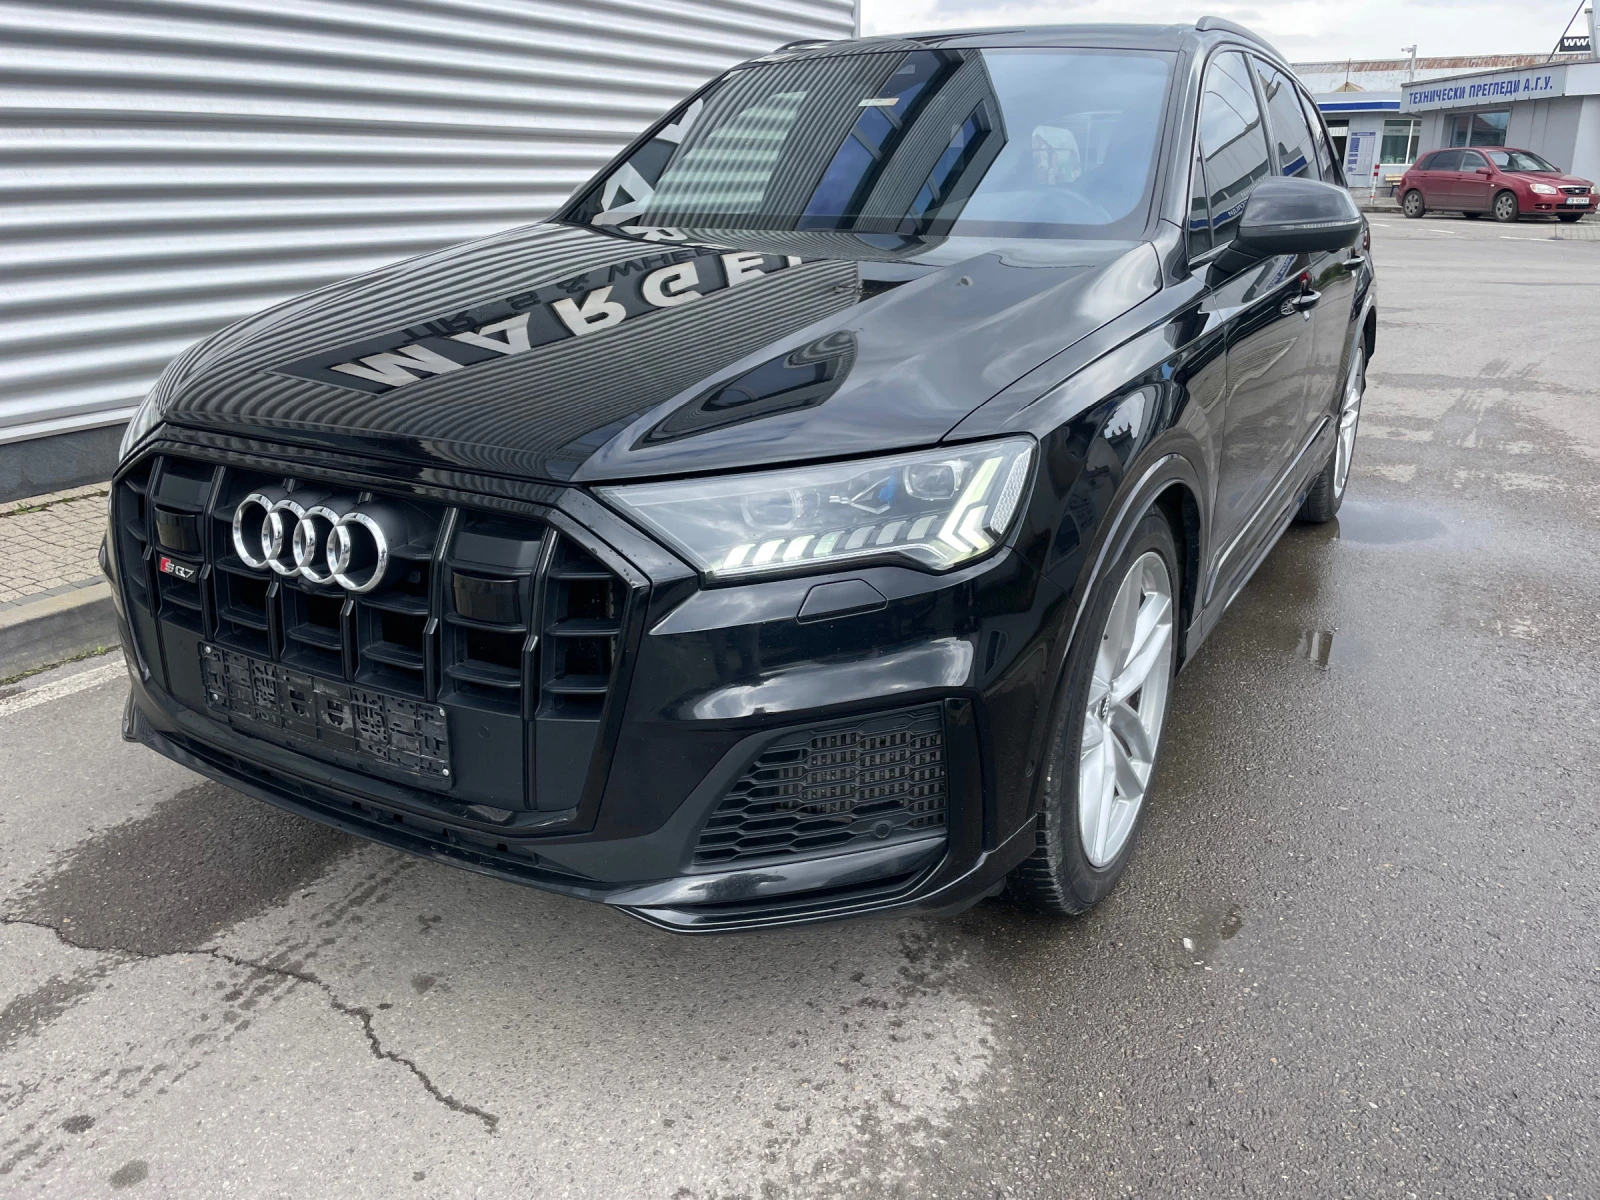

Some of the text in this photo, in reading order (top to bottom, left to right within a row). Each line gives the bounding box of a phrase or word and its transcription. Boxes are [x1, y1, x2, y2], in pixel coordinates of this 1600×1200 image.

[1408, 75, 1553, 106] ТЕХНИЧЕСКИ ПРЕГЛЕДИ А.Г.У.
[162, 557, 195, 579] SQ7
